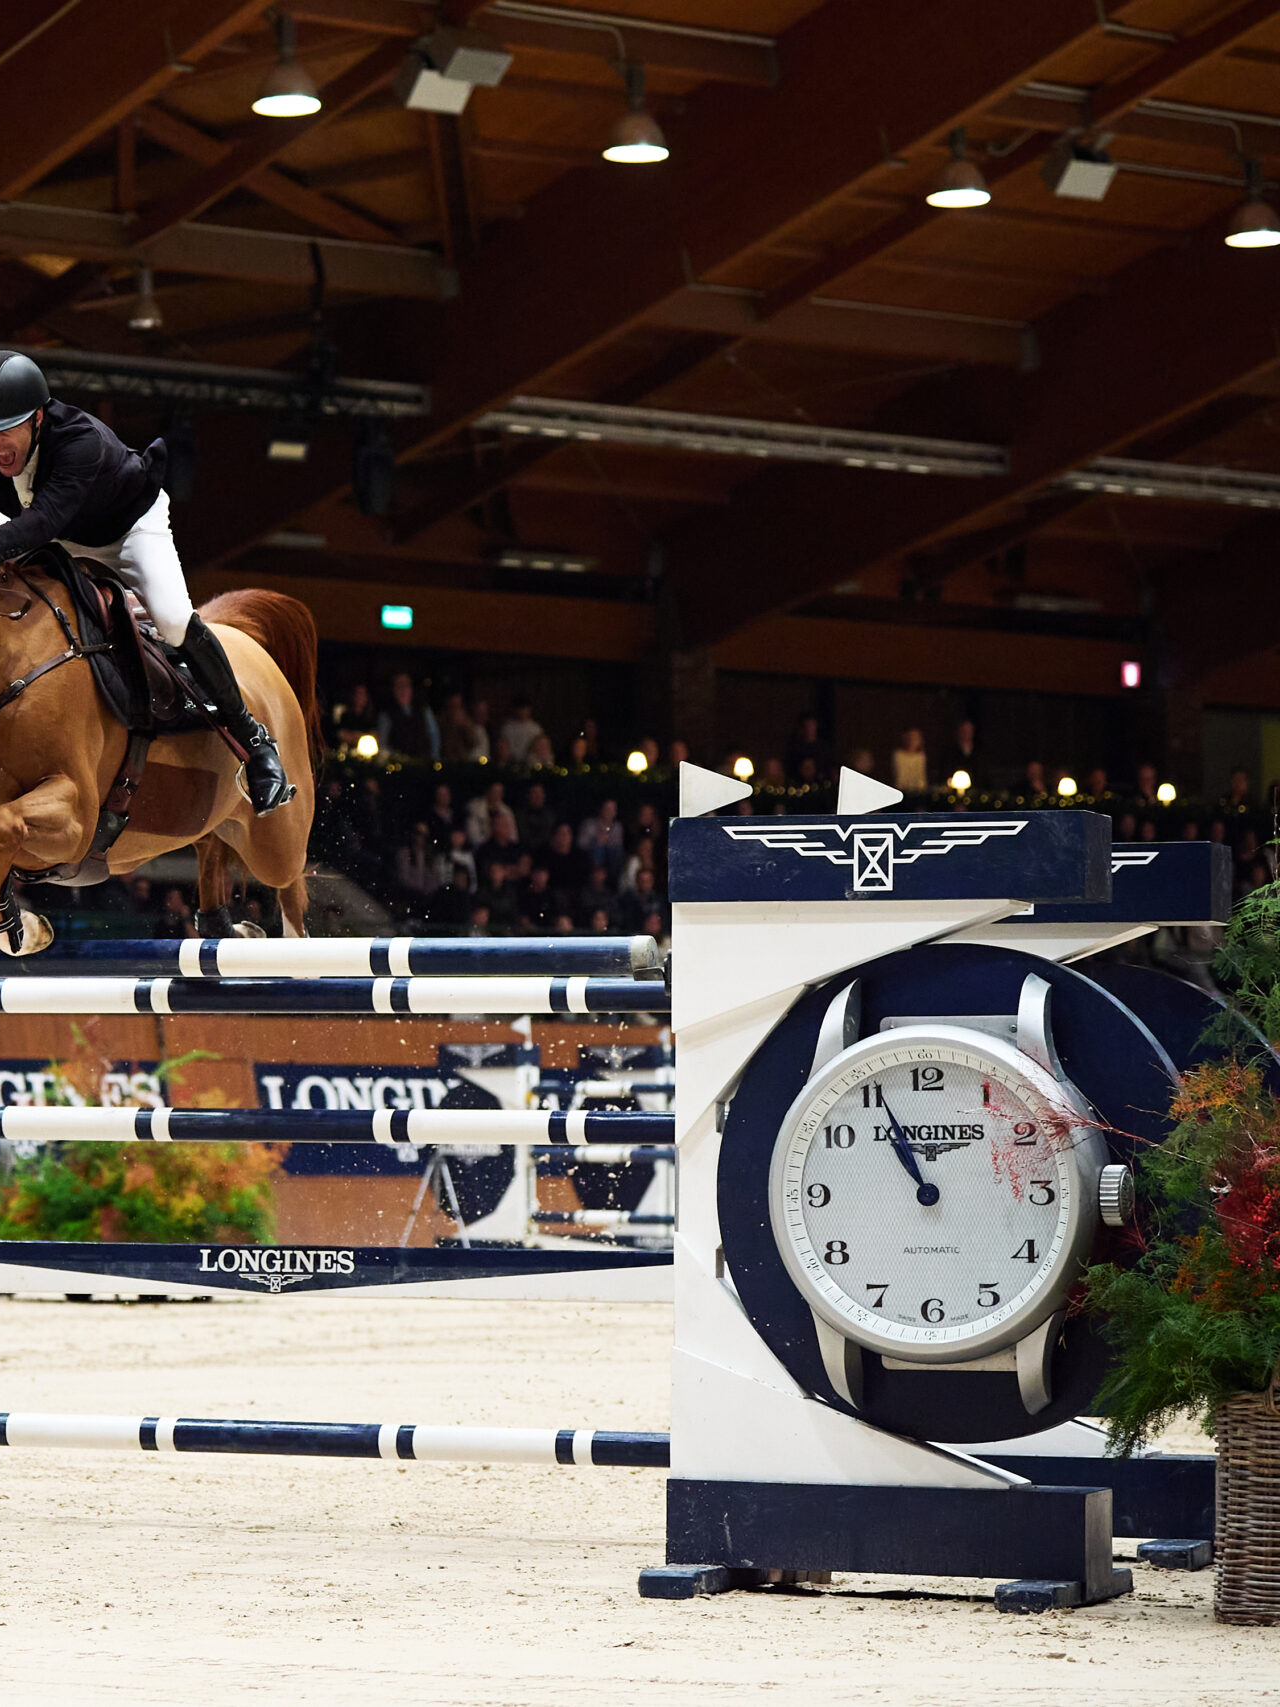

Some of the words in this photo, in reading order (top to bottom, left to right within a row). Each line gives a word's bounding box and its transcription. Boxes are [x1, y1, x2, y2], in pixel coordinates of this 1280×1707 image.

[918, 1052, 932, 1060] 60
[910, 1066, 944, 1091] 12
[860, 1084, 884, 1108] 11
[823, 1124, 855, 1149] 10
[1013, 1122, 1037, 1146] 2
[807, 1183, 832, 1208] 9
[1029, 1180, 1055, 1205] 3
[199, 1248, 355, 1274] LONGINES
[824, 1240, 850, 1265] 8
[903, 1246, 960, 1255] AUTOMATIC
[1010, 1239, 1040, 1264] 4
[866, 1283, 890, 1308] 7
[977, 1281, 1000, 1307] 5
[920, 1298, 945, 1323] 6
